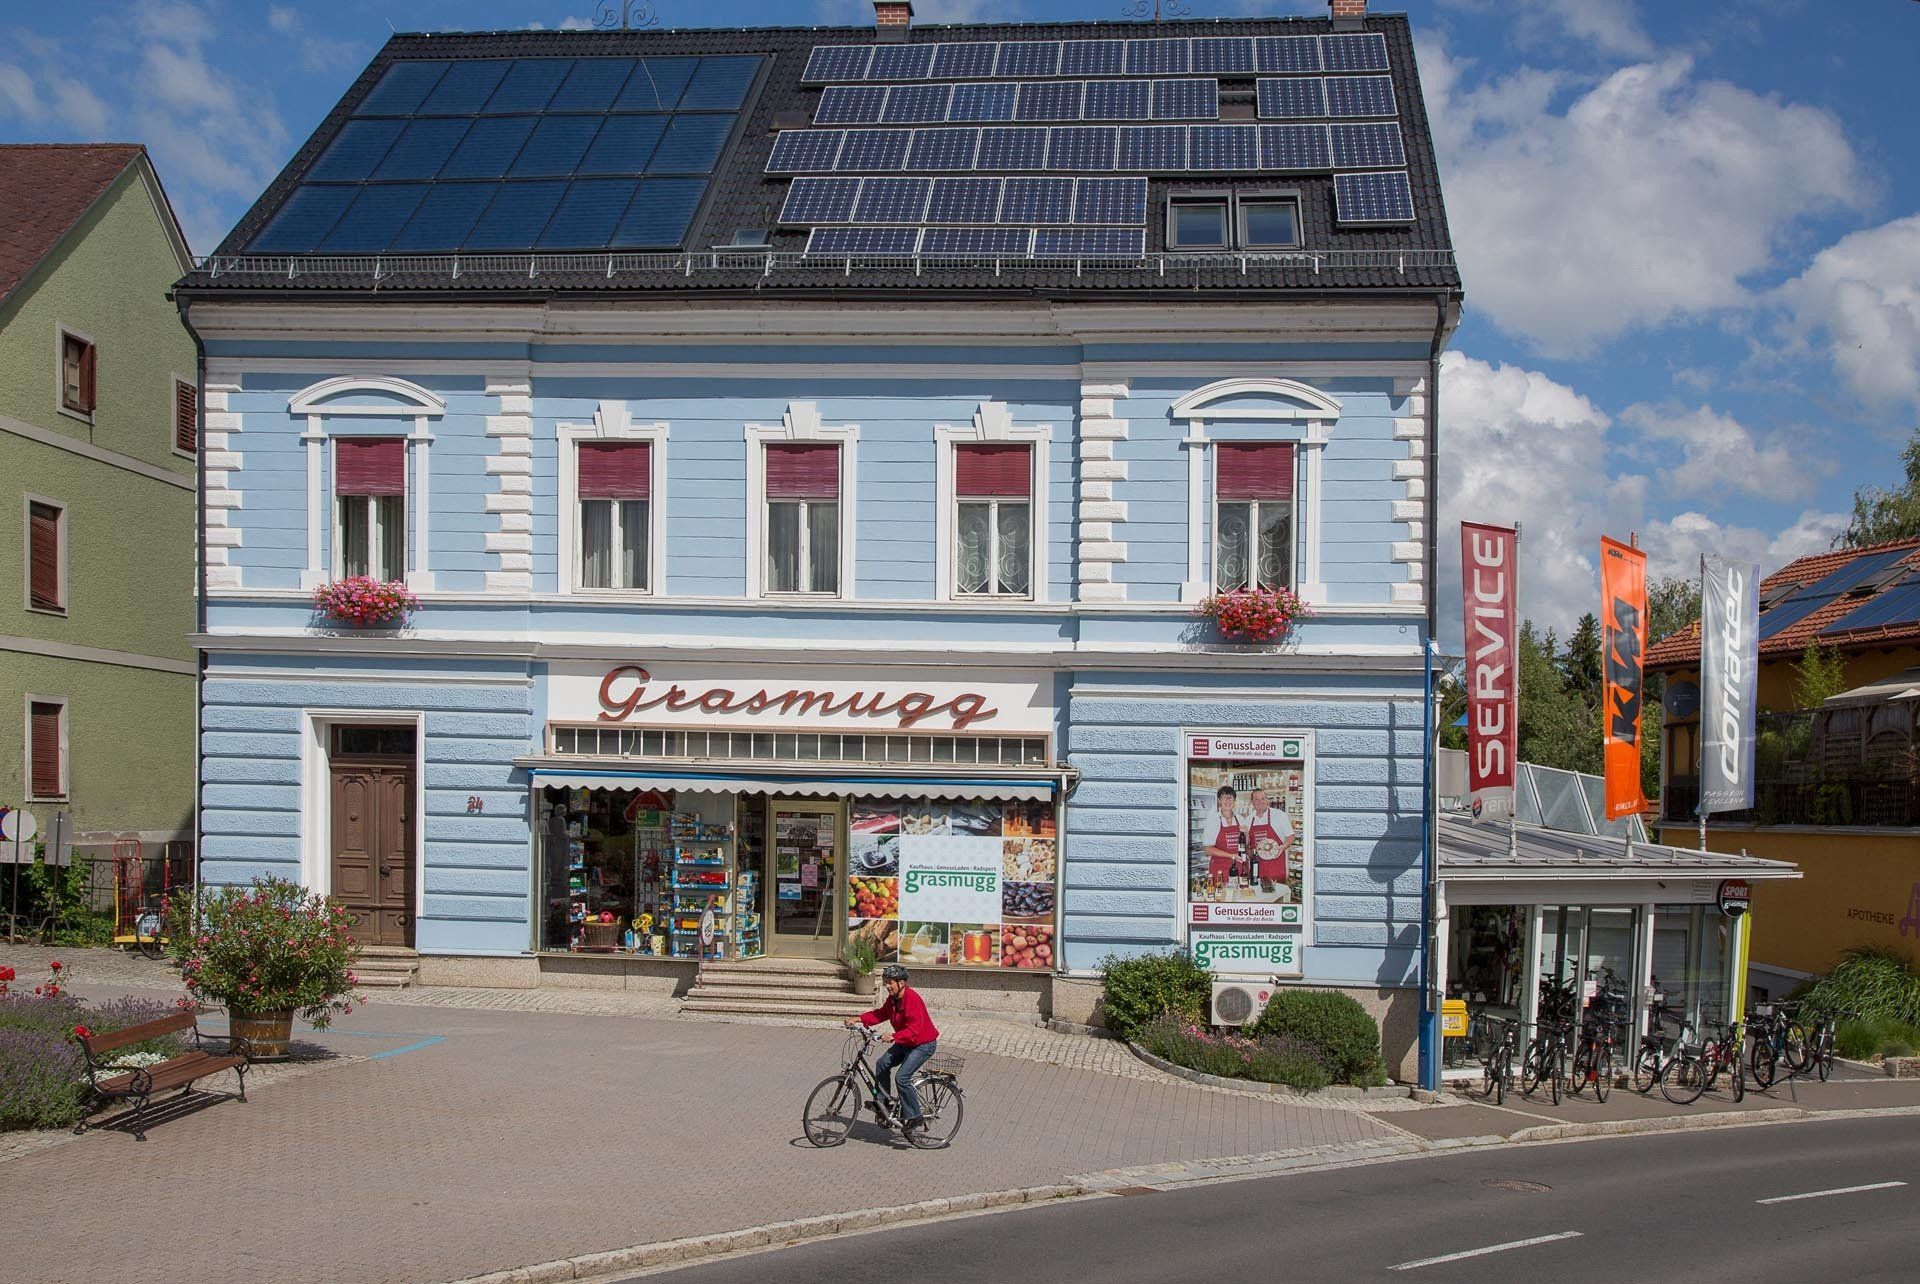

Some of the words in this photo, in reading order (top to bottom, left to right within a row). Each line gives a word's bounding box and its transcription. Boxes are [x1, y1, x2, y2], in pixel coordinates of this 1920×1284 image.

[1472, 532, 1505, 779] SERVICE
[1606, 597, 1642, 748] KTM
[1721, 567, 1744, 786] corratec
[597, 665, 999, 730] Grasmugg
[1215, 740, 1276, 751] GenussLaden
[904, 870, 997, 893] grasmugg
[1724, 886, 1748, 897] SPORT
[1215, 906, 1275, 917] GenussLaden
[1847, 908, 1895, 925] APOTHEKE
[1195, 941, 1293, 969] grasmugg
